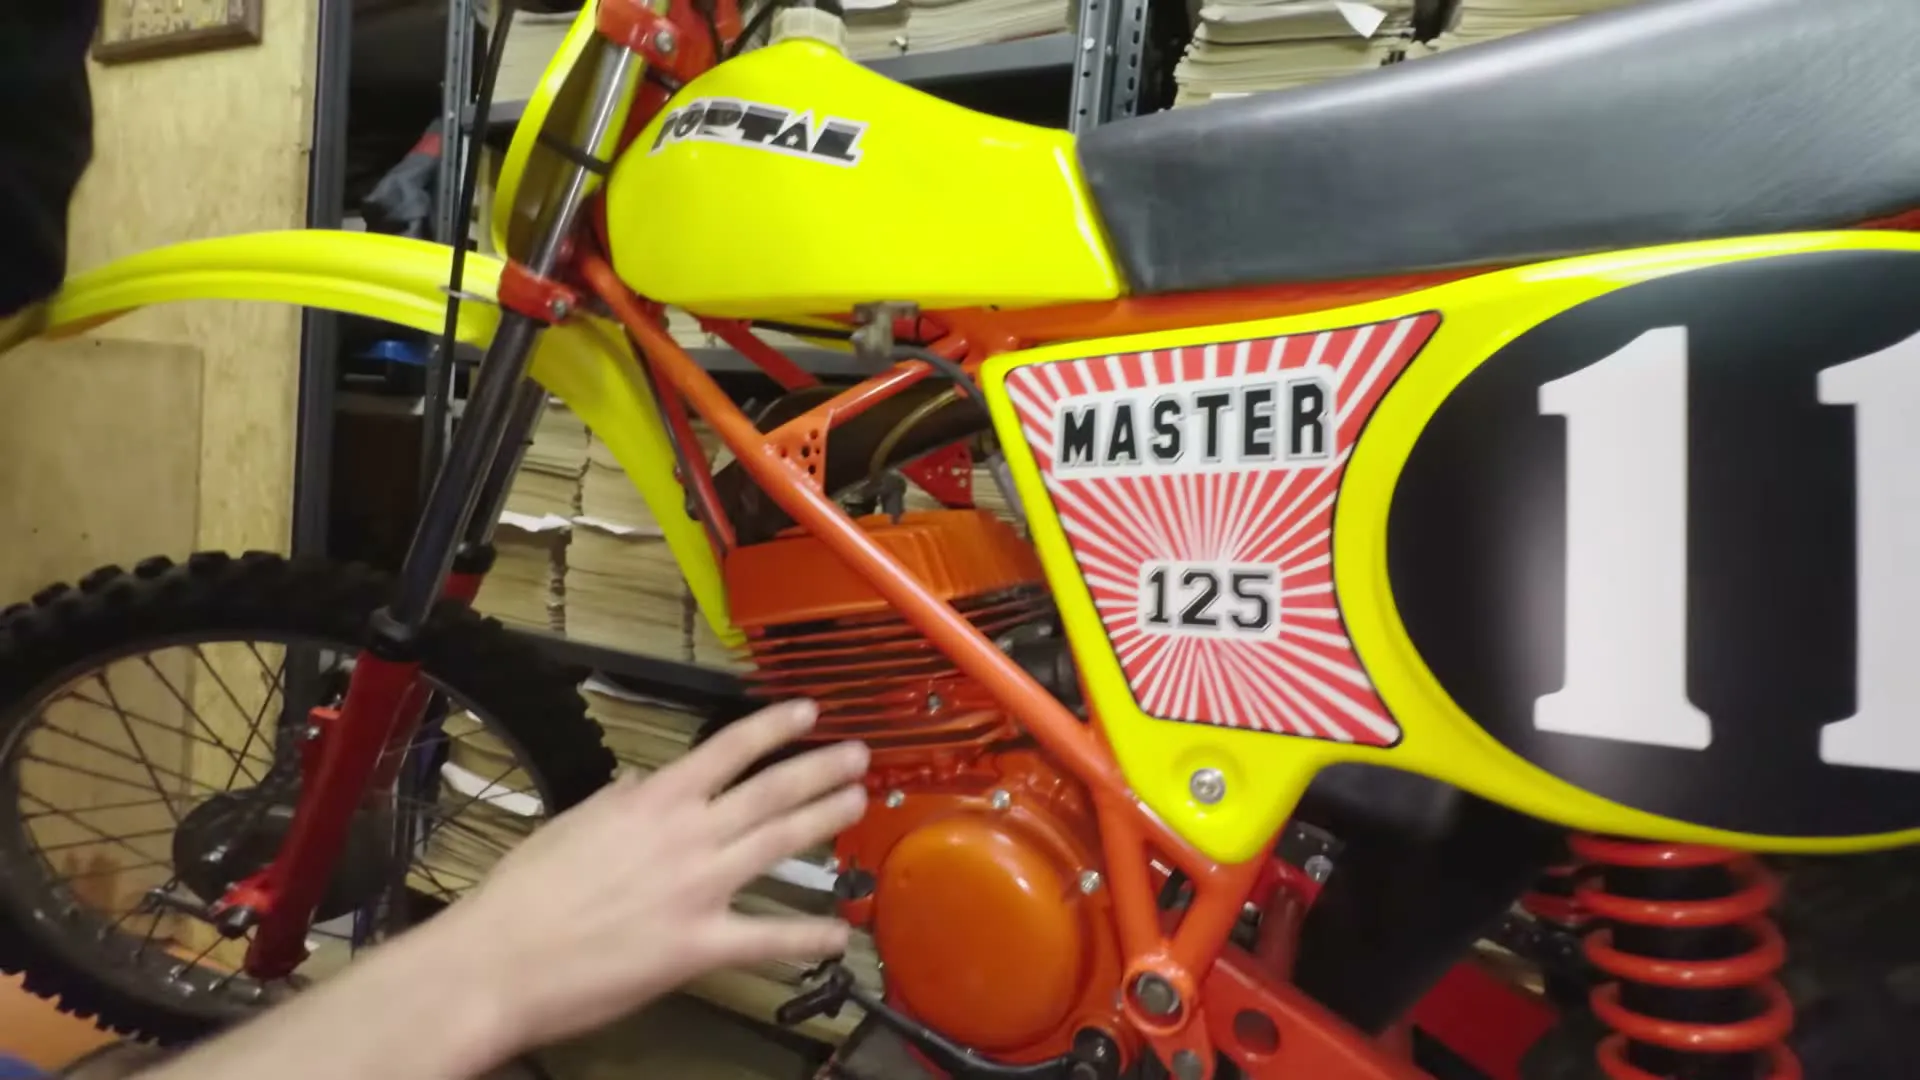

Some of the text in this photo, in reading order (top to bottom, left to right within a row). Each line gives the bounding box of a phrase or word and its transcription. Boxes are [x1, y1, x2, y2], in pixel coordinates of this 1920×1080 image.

[1059, 378, 1328, 466] MASTER
[1533, 325, 1920, 772] 11
[1147, 568, 1271, 630] 125
